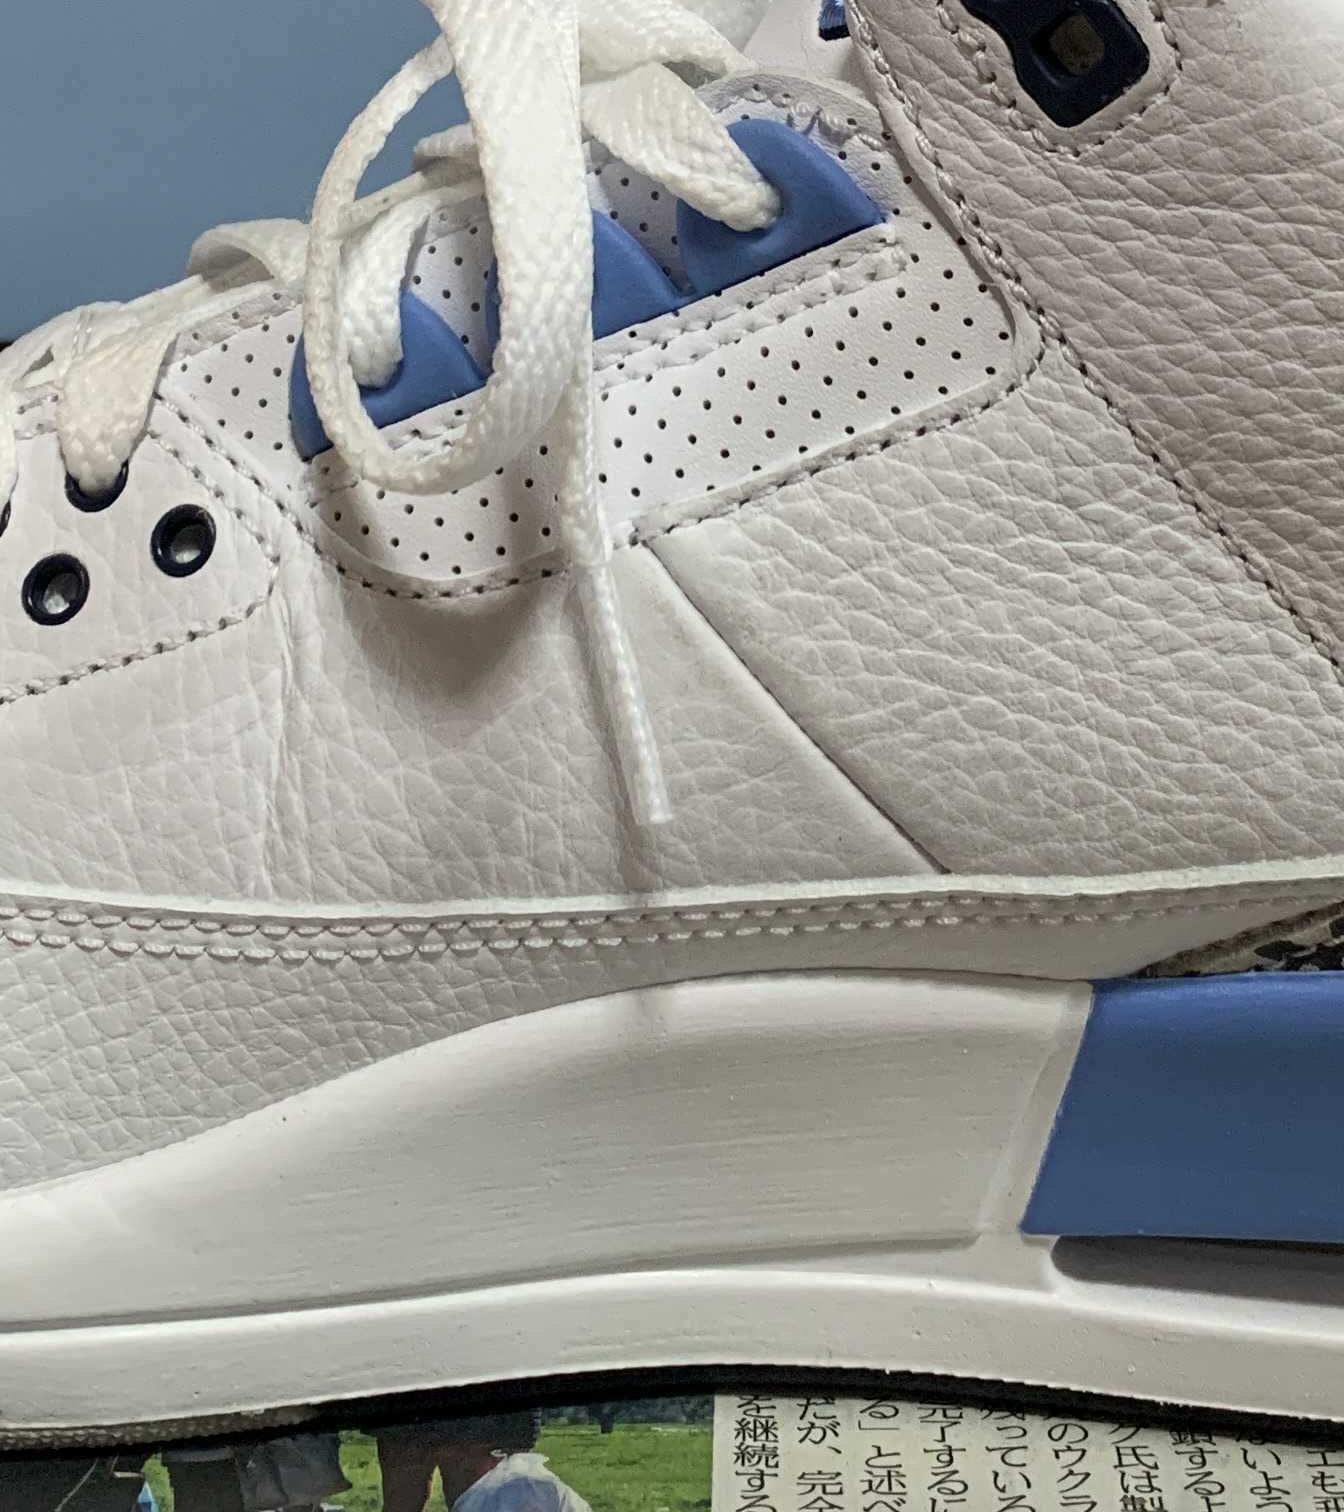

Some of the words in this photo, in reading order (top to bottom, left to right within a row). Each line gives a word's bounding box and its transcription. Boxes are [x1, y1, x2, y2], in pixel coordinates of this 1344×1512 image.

[1044, 1415, 1098, 1512] のウクラ
[1236, 1431, 1293, 1512] いよう
